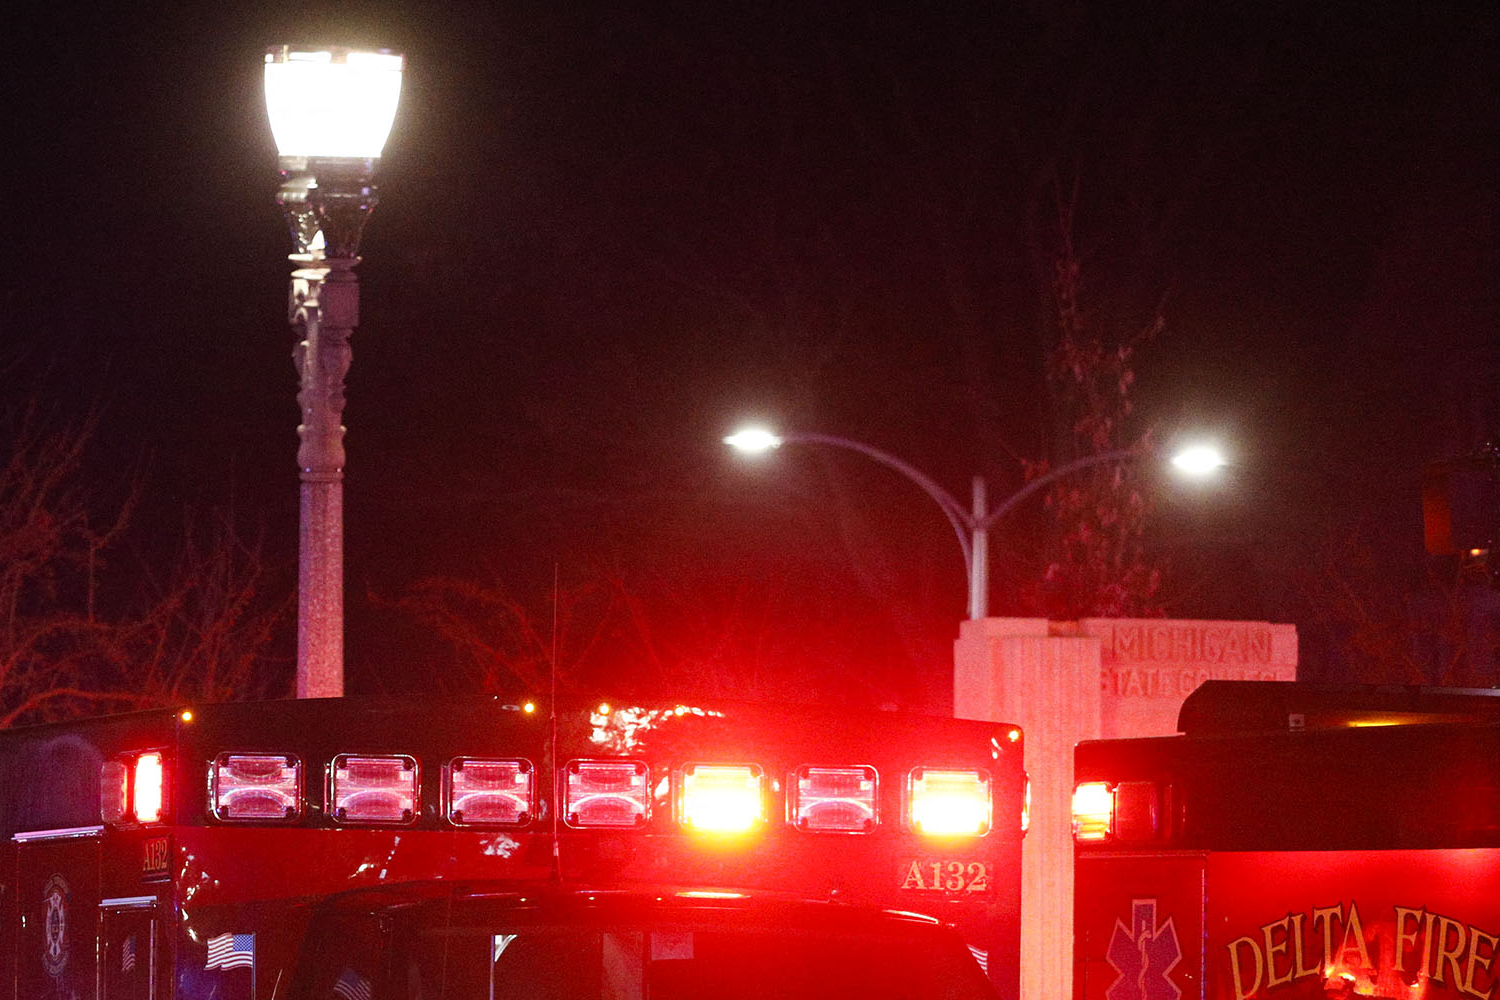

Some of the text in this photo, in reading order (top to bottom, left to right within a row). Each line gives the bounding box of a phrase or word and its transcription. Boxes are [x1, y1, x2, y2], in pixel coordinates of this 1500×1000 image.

[1111, 624, 1273, 663] MICHIGAN
[1100, 666, 1175, 698] STATE
[143, 839, 168, 871] A132
[901, 860, 987, 892] A132
